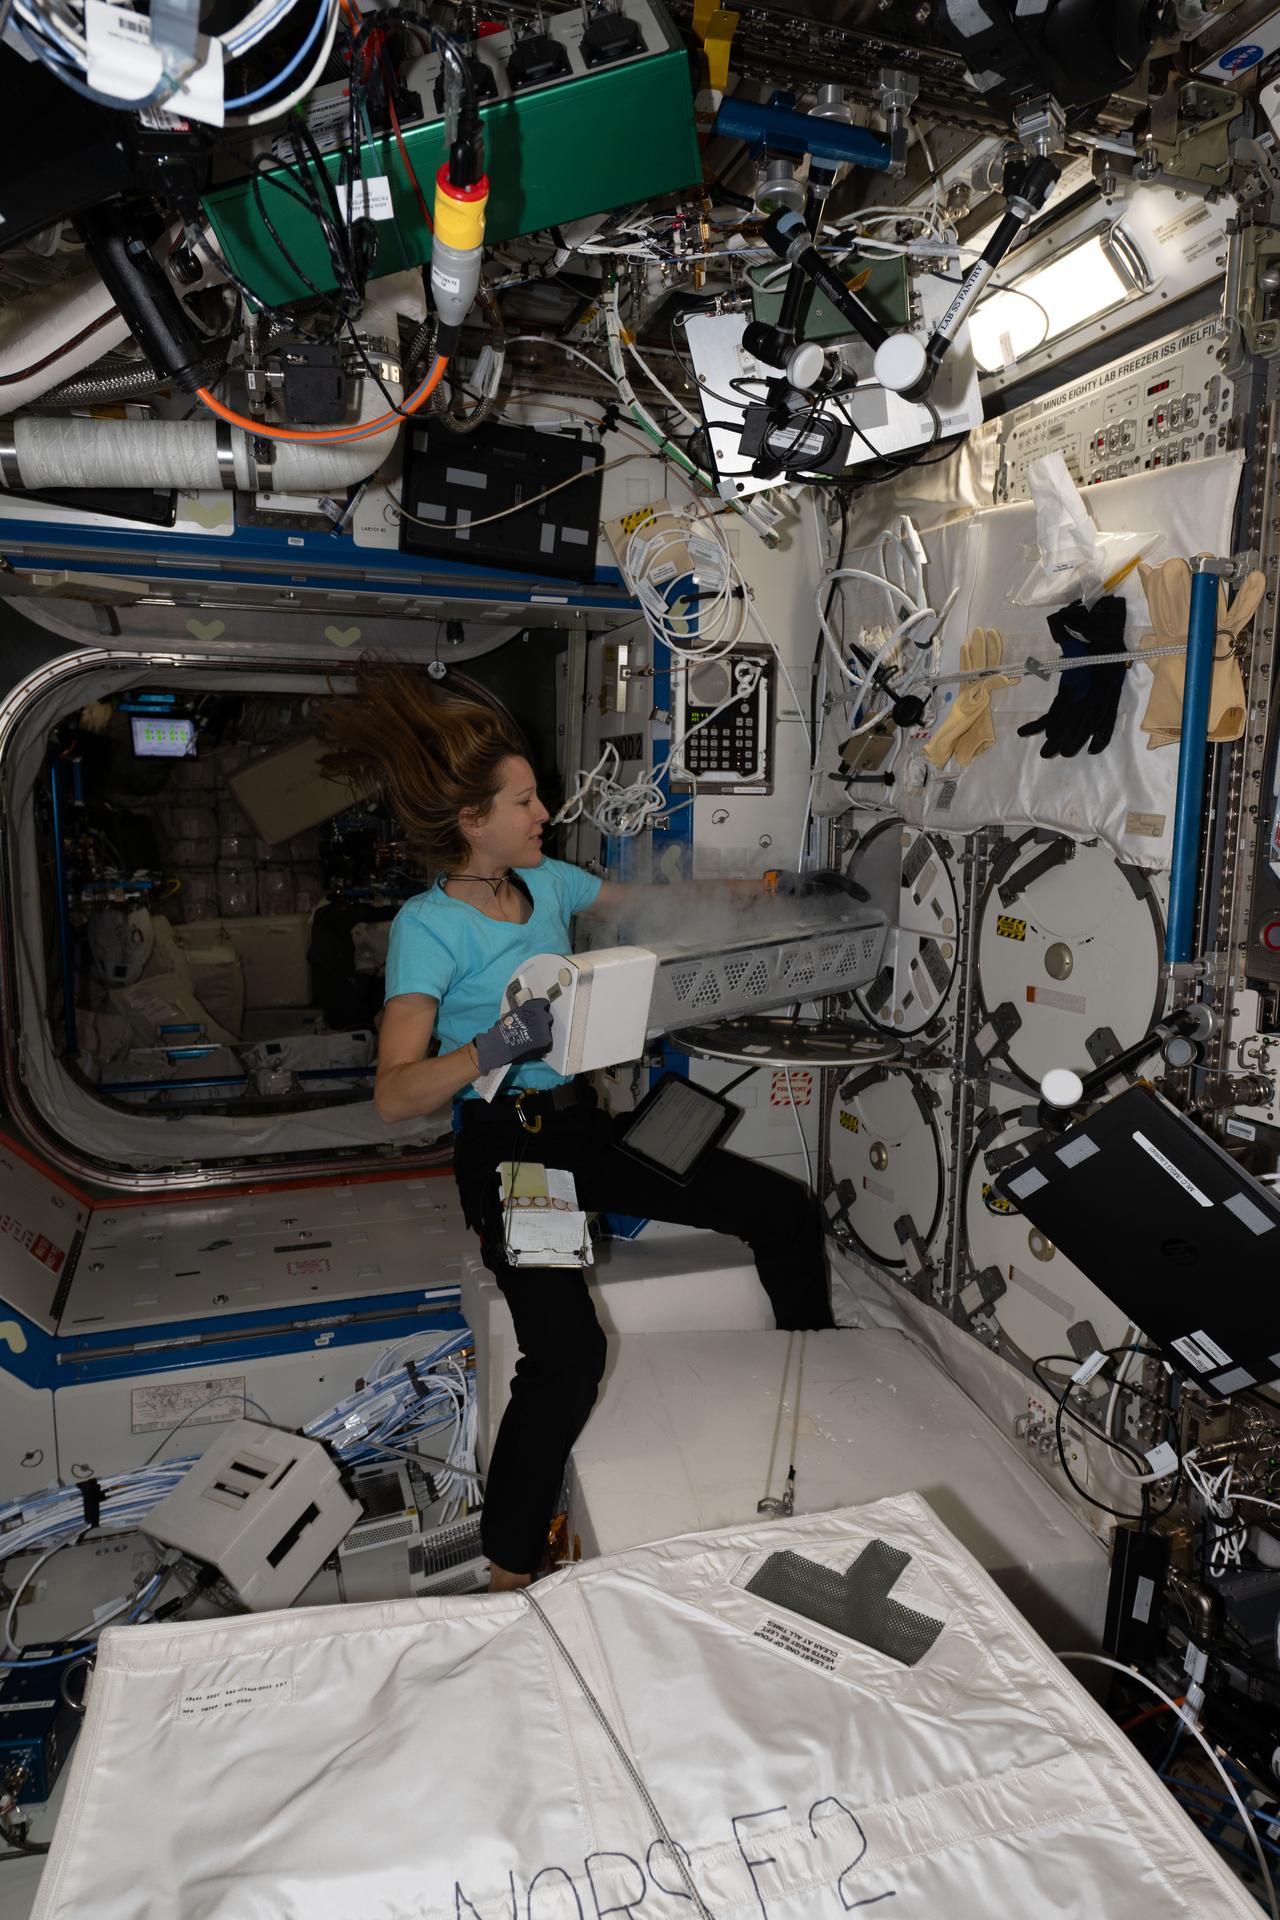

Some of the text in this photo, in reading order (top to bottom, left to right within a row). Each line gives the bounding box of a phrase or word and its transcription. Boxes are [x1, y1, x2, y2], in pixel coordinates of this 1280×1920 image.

[940, 313, 954, 330] LAB
[959, 265, 982, 301] PANTRY
[1043, 394, 1067, 411] MINUS
[1068, 380, 1097, 400] EIGHTY
[1099, 372, 1116, 386] LAB
[1118, 351, 1158, 377] FREEZER
[1161, 344, 1176, 358] ISS
[1178, 323, 1216, 350] (MELFI)
[1217, 320, 1224, 332] 3
[1148, 1146, 1195, 1192] MLC (MSG Laptop)
[753, 1631, 774, 1643] FOUR
[762, 1626, 835, 1664] VENTS MUST BE LEFT
[766, 1620, 839, 1658] CLEAR AT ALL TIMES
[773, 1640, 784, 1648] OF
[784, 1644, 800, 1656] ONE
[801, 1653, 824, 1667] LEAST
